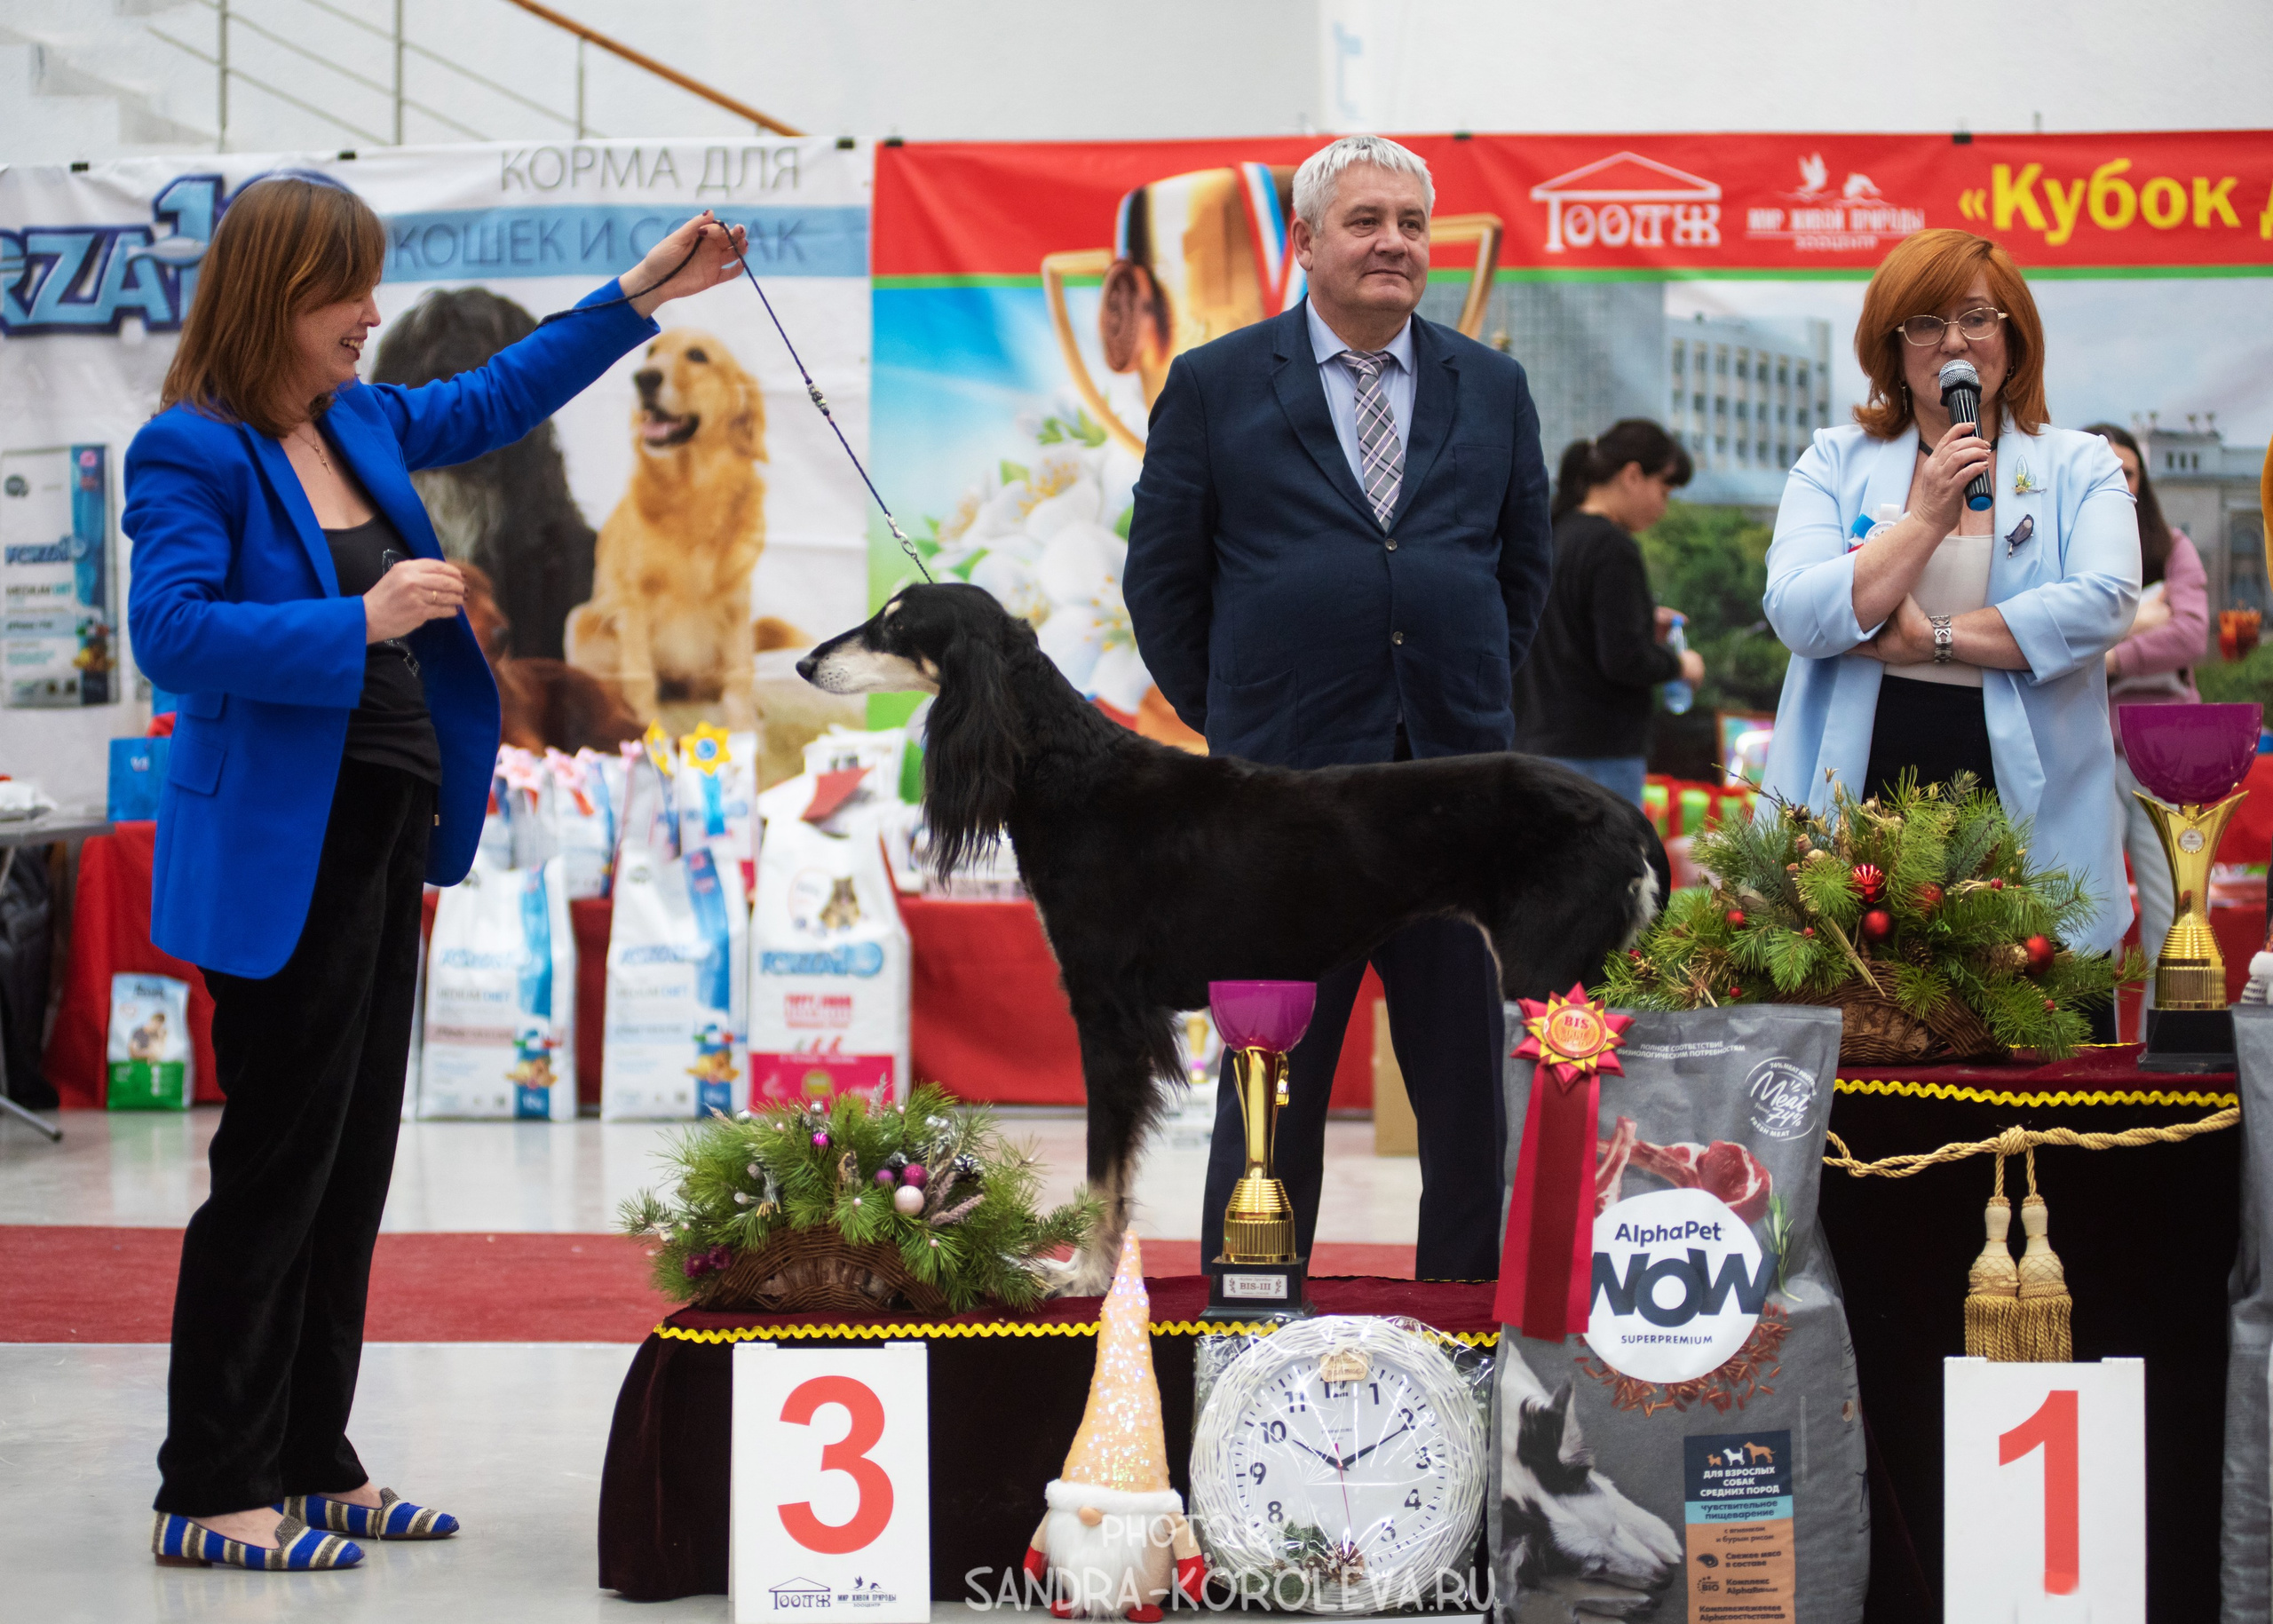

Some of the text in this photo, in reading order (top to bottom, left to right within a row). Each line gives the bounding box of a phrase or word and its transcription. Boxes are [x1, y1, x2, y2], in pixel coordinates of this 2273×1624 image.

[501, 146, 799, 198] КОРМА ДЛЯ
[1959, 157, 2242, 247] «Кубок
[392, 215, 806, 269] КОШЕК И САК
[1564, 1015, 1590, 1030] BIS
[1616, 1045, 1746, 1060] ФИЗИОЛОГИЧЕСКИМ ПОТРЕБНОСТЯМ
[1640, 1041, 1724, 1052] ПОЛНОЕ СООТВЕТСТВИЕ
[1750, 1071, 1811, 1113] Meat
[1750, 1116, 1770, 1135] FRESH
[1614, 1221, 1723, 1248] AlphaPet
[1620, 1334, 1714, 1345] SUPERPREMIUM
[1284, 1390, 1306, 1414] 11
[1368, 1382, 1380, 1406] 1
[1398, 1407, 1416, 1431] 2
[1259, 1420, 1287, 1445] 10
[777, 1374, 894, 1555] 3
[1415, 1446, 1431, 1470] 3
[1249, 1462, 1267, 1485] 9
[1703, 1467, 1776, 1479] ДЛЯ ВЗРОСЛЫХ
[1723, 1477, 1755, 1486] СОБАК
[1404, 1488, 1422, 1510] 4
[1699, 1485, 1780, 1498] СРЕДНИХ ПОРОД
[1999, 1390, 2079, 1596] 1
[1267, 1501, 1284, 1524] 8
[1700, 1500, 1778, 1513] чувствительное
[1705, 1509, 1775, 1520] пищеварение
[852, 1593, 869, 1602] ЖИВОЙ
